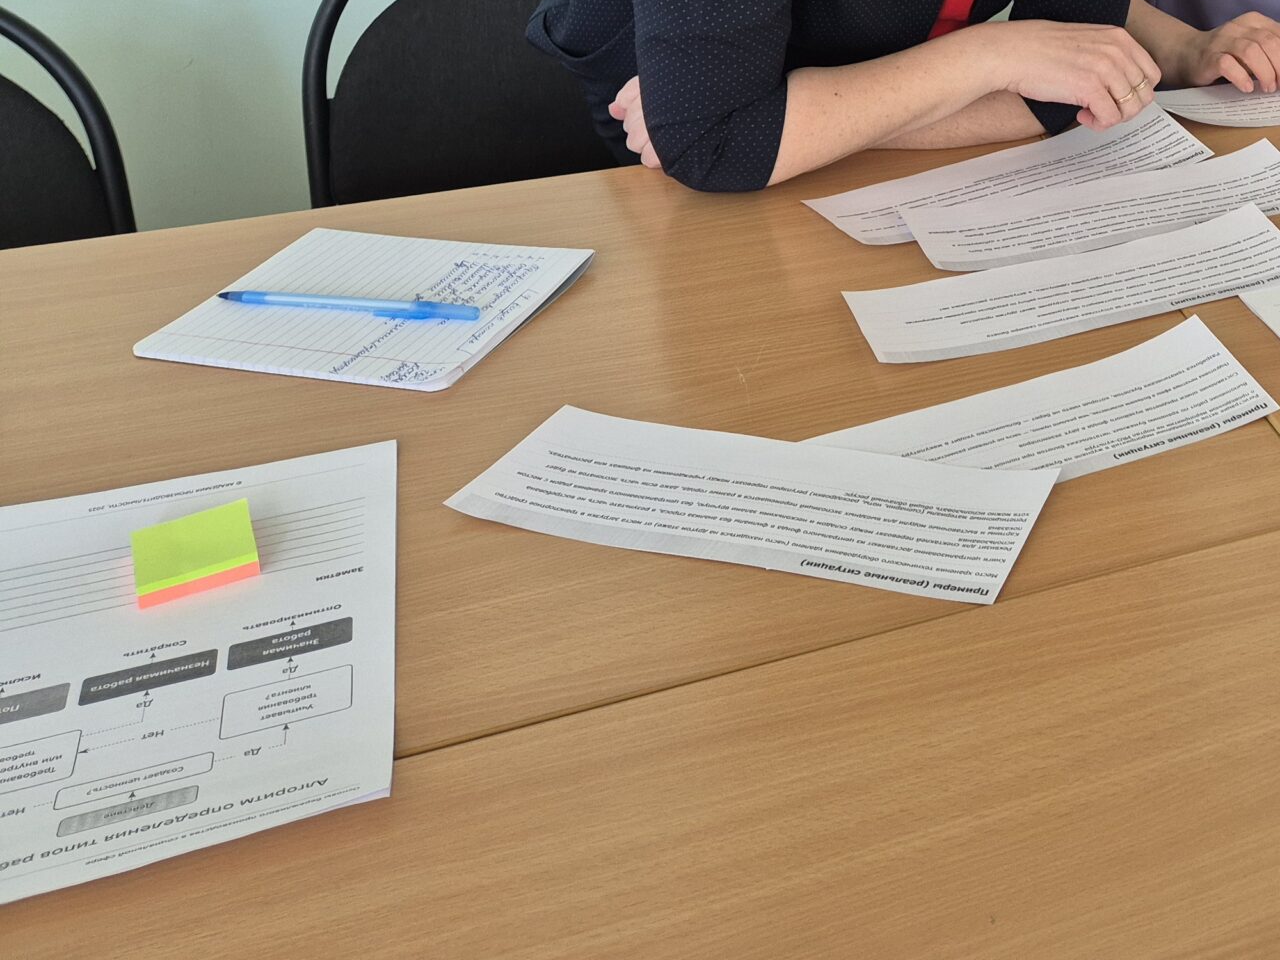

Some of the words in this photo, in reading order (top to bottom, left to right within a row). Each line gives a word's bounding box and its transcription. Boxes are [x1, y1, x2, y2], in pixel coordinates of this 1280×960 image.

[1218, 279, 1264, 295] (реальные
[1170, 290, 1217, 307] ситуации)
[1186, 352, 1220, 371] Разработка
[1222, 402, 1268, 425] Примеры
[1167, 422, 1221, 443] (реальные
[1113, 440, 1166, 460] ситуации)
[195, 482, 234, 493] АКАДЕМИЯ
[494, 491, 527, 504] средство
[587, 498, 607, 506] часть
[609, 501, 650, 512] результате
[658, 508, 686, 517] спроса,
[587, 511, 619, 521] загрузки
[621, 517, 642, 525] места
[687, 512, 717, 521] анализа
[719, 516, 732, 524] без
[733, 518, 768, 529] филиалы
[654, 521, 679, 531] этаже)
[681, 525, 707, 534] другом
[776, 524, 801, 535] фонда
[720, 530, 763, 542] находиться
[765, 536, 790, 547] (часто
[791, 541, 823, 552] удалено
[868, 540, 912, 552] доставляют
[316, 566, 364, 582] Заметки
[801, 560, 861, 577] ситуации)
[936, 565, 972, 575] хранения
[975, 571, 998, 579] Место
[864, 570, 929, 589] (реальные
[933, 582, 989, 597] Примеры
[242, 604, 342, 631] Оптимизировать
[271, 628, 312, 644] работа
[123, 640, 187, 657] Сократить
[262, 638, 320, 656] Значимая
[135, 659, 209, 682] Незначимая
[282, 664, 299, 675] Да
[90, 676, 133, 692] работа
[265, 684, 312, 700] клиента?
[136, 699, 154, 709] Да
[258, 693, 318, 711] требования
[260, 704, 314, 721] Учитывает
[141, 729, 165, 740] Нет
[41, 754, 62, 764] или
[244, 746, 262, 757] Да
[0, 766, 56, 784] Требован
[142, 766, 184, 781] Создает
[86, 776, 141, 795] ценность?
[240, 778, 328, 806] Алгоритм
[0, 807, 26, 818] Нет
[103, 802, 155, 819] Действие
[259, 797, 322, 817] бережливого
[104, 802, 234, 842] определения
[189, 815, 257, 836] производства
[40, 839, 97, 859] типов
[118, 836, 178, 857] социальной
[84, 853, 116, 866] сфере
